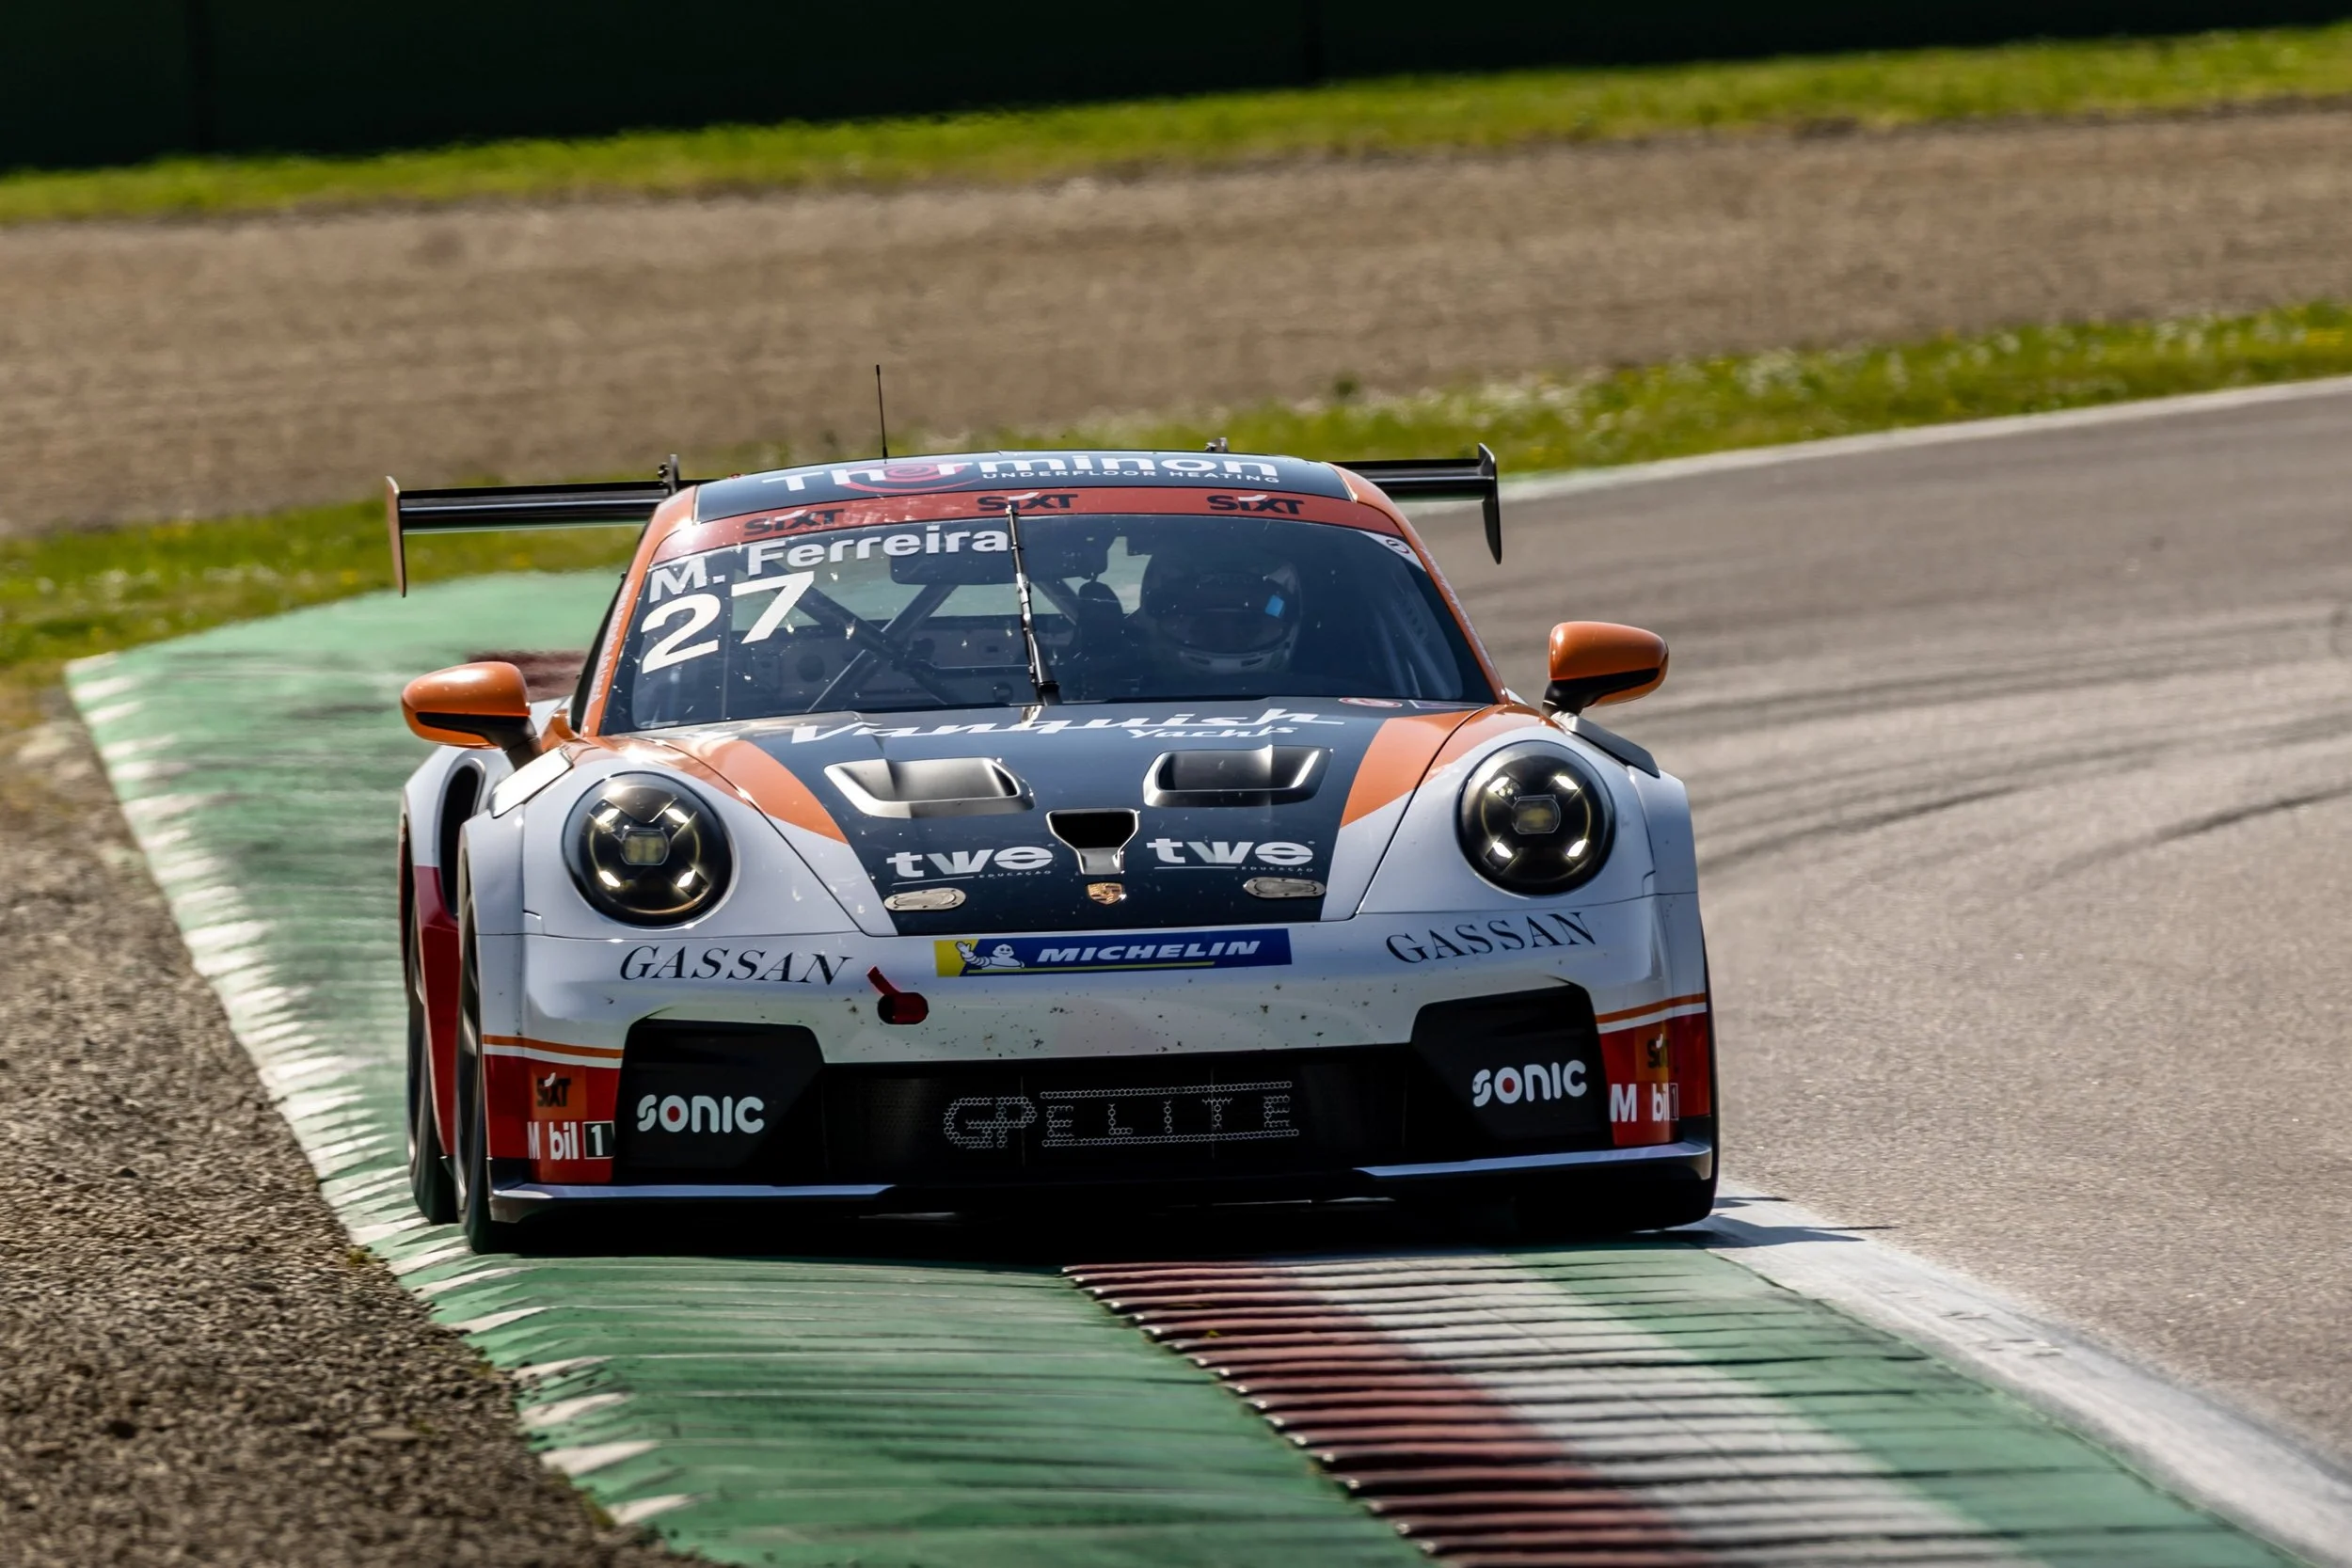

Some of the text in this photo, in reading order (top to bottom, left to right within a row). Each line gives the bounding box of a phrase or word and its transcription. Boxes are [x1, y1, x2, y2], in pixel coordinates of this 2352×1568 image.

[982, 470, 1280, 483] UNDERFLOOR HEATING
[648, 525, 1009, 603] M. Ferreira
[641, 570, 816, 674] 27
[790, 707, 1345, 744] Vanquish
[1128, 725, 1298, 740] Yachts
[886, 846, 1054, 879] twe
[1145, 837, 1314, 866] twe
[1036, 940, 1262, 963] MICHELIN
[1385, 911, 1597, 964] GASSAN
[619, 944, 854, 986] GASSAN
[1609, 1083, 1671, 1123] Mbil
[527, 1120, 580, 1161] Mbil
